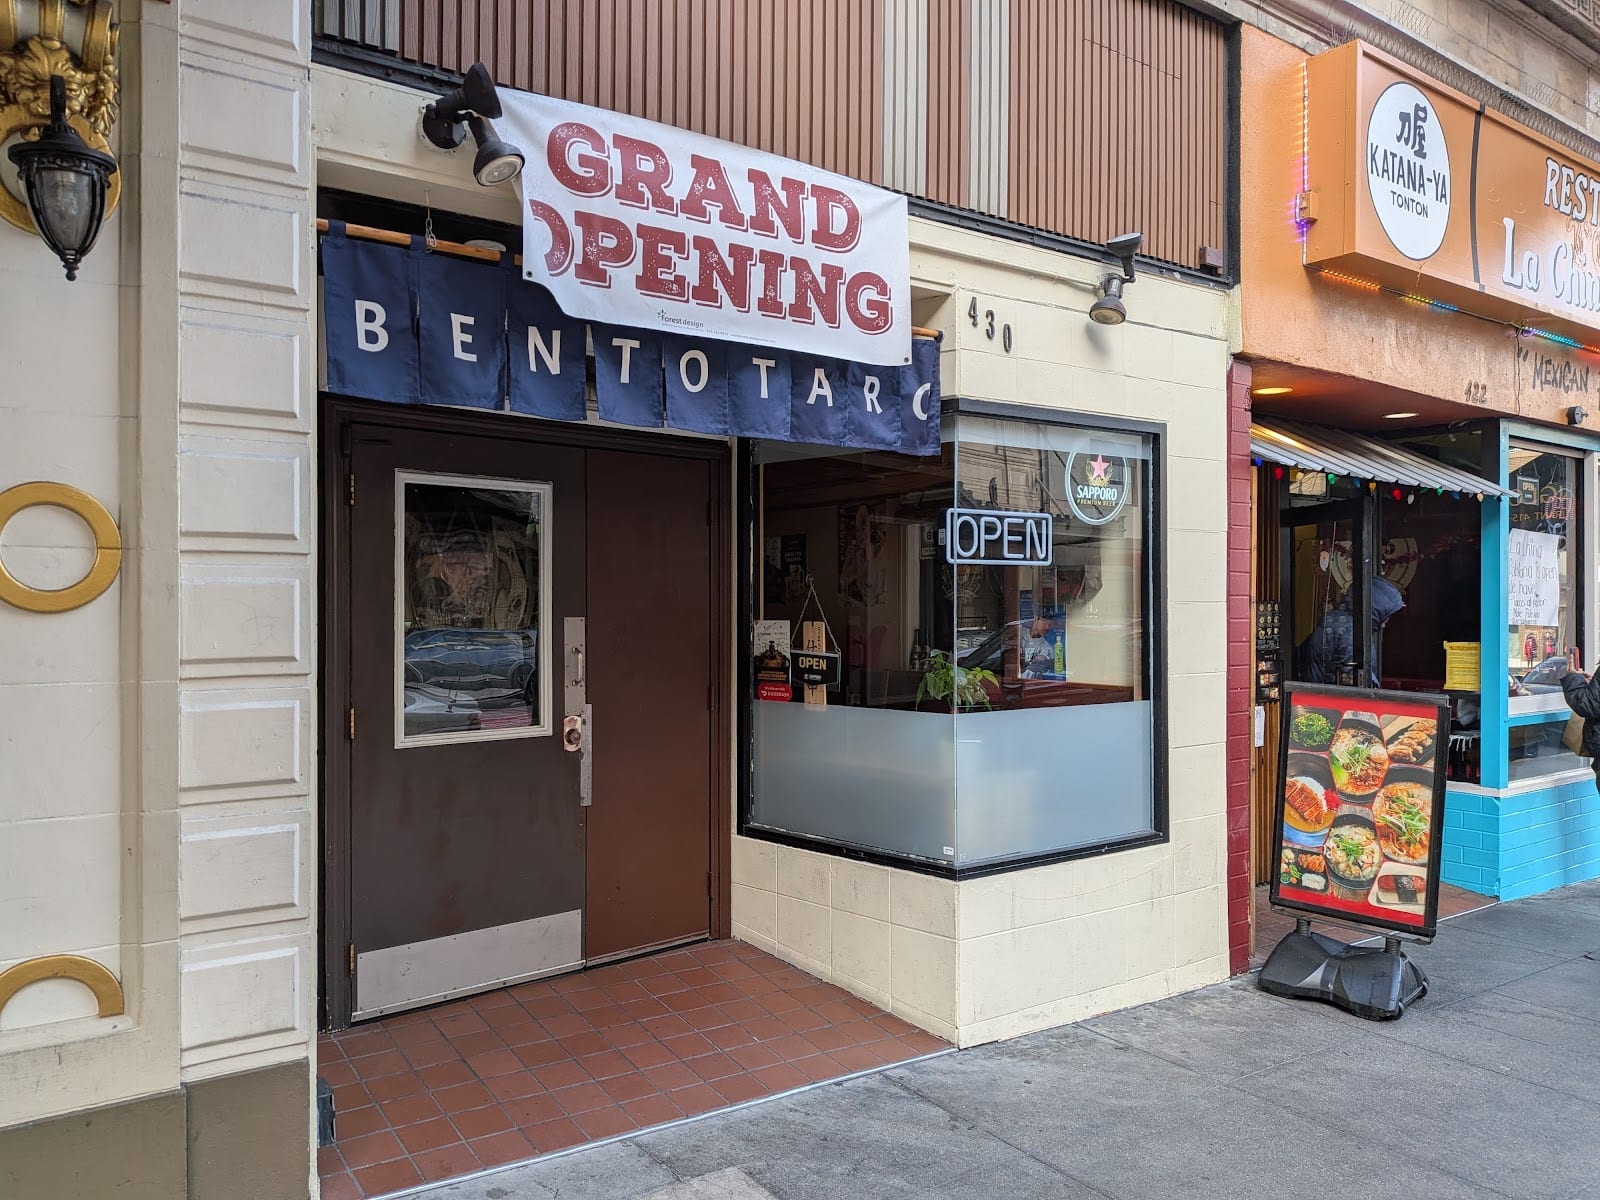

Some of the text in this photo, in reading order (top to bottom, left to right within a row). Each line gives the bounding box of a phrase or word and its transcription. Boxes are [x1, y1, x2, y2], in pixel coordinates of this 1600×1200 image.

[547, 122, 862, 254] GRAND
[1370, 142, 1448, 205] KATANA-YA
[1390, 190, 1429, 218] TONTON
[1502, 217, 1541, 293] La
[968, 296, 1012, 354] 430
[1464, 380, 1487, 404] 422
[1077, 485, 1118, 501] SAPPORO
[1077, 498, 1102, 506] PREMIUM
[956, 515, 1048, 560] OPEN
[799, 656, 827, 671] OPEN
